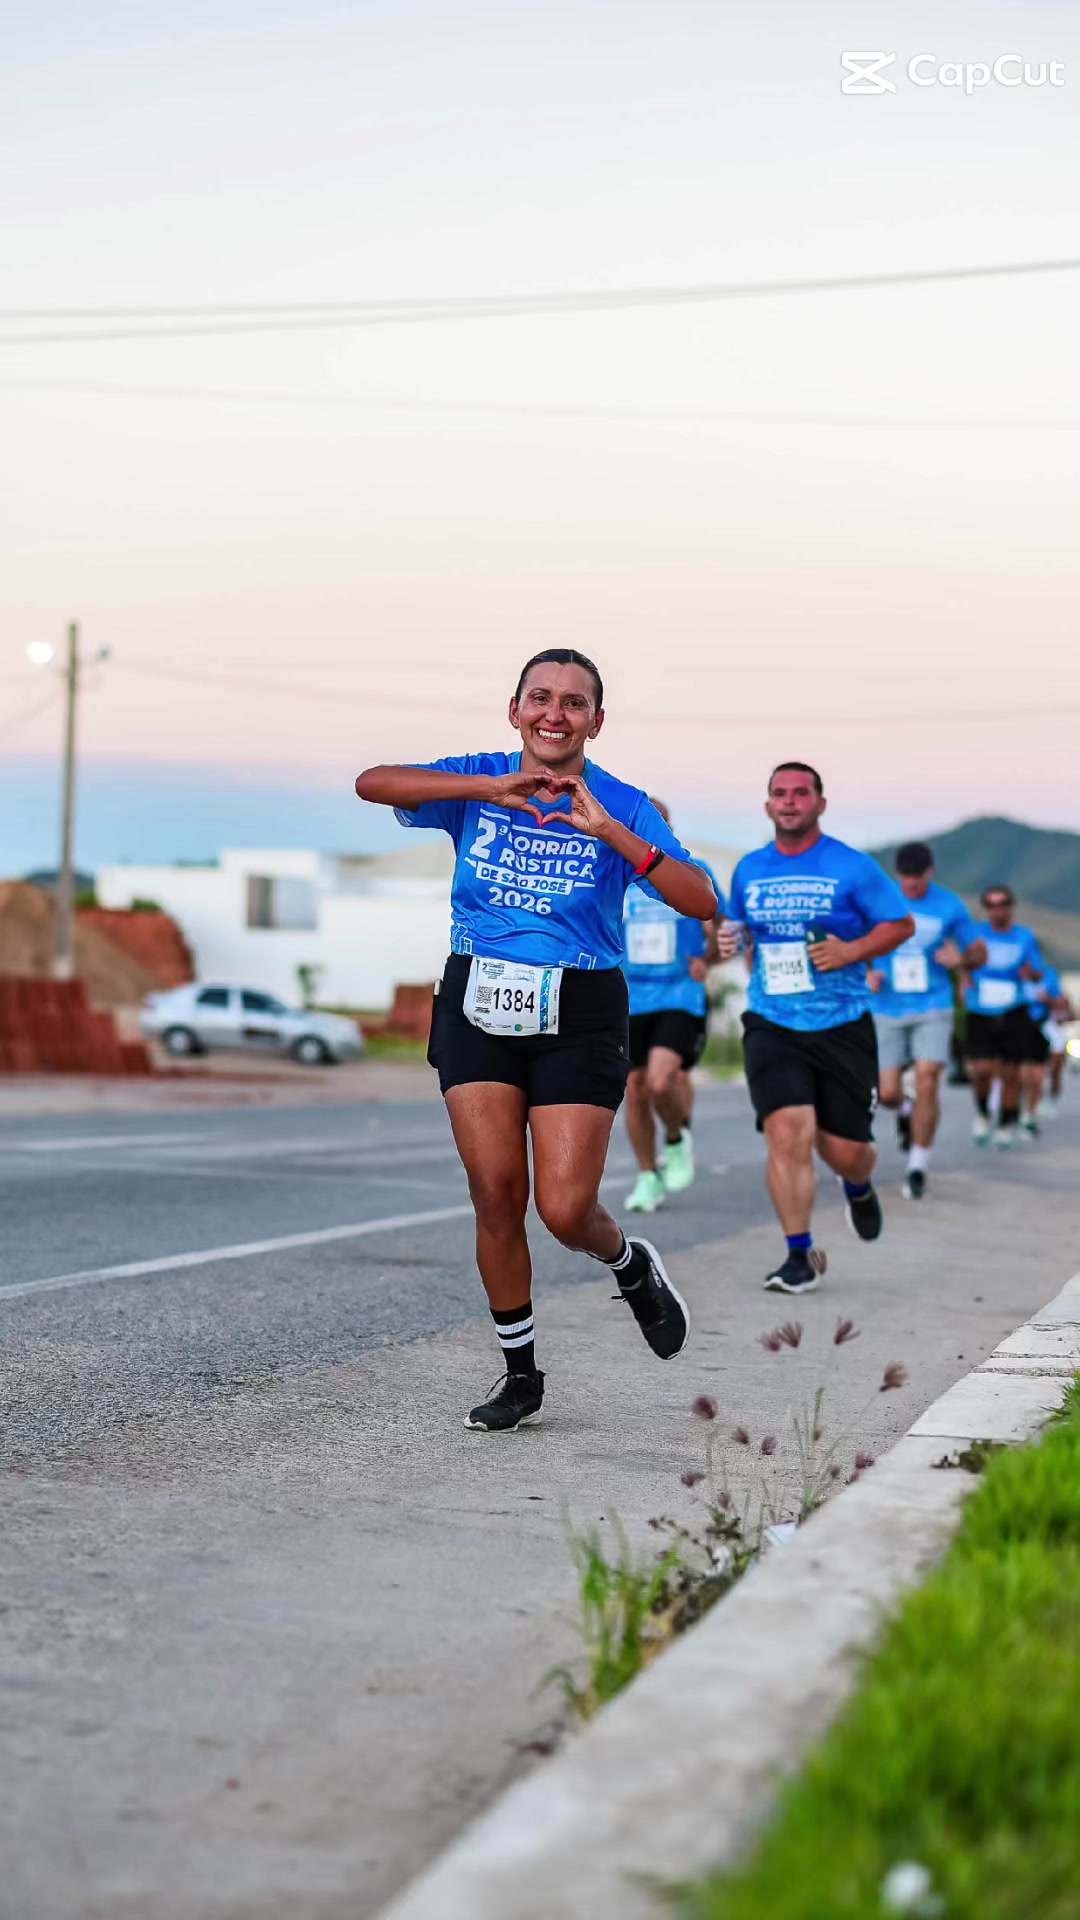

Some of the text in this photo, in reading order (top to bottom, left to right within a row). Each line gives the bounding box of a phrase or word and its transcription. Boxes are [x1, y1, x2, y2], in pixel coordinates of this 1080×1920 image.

[499, 848, 595, 880] RÚSTICA
[480, 867, 568, 893] DE SÃO JOSÉ
[488, 886, 552, 916] 2026
[493, 987, 534, 1013] 1384
